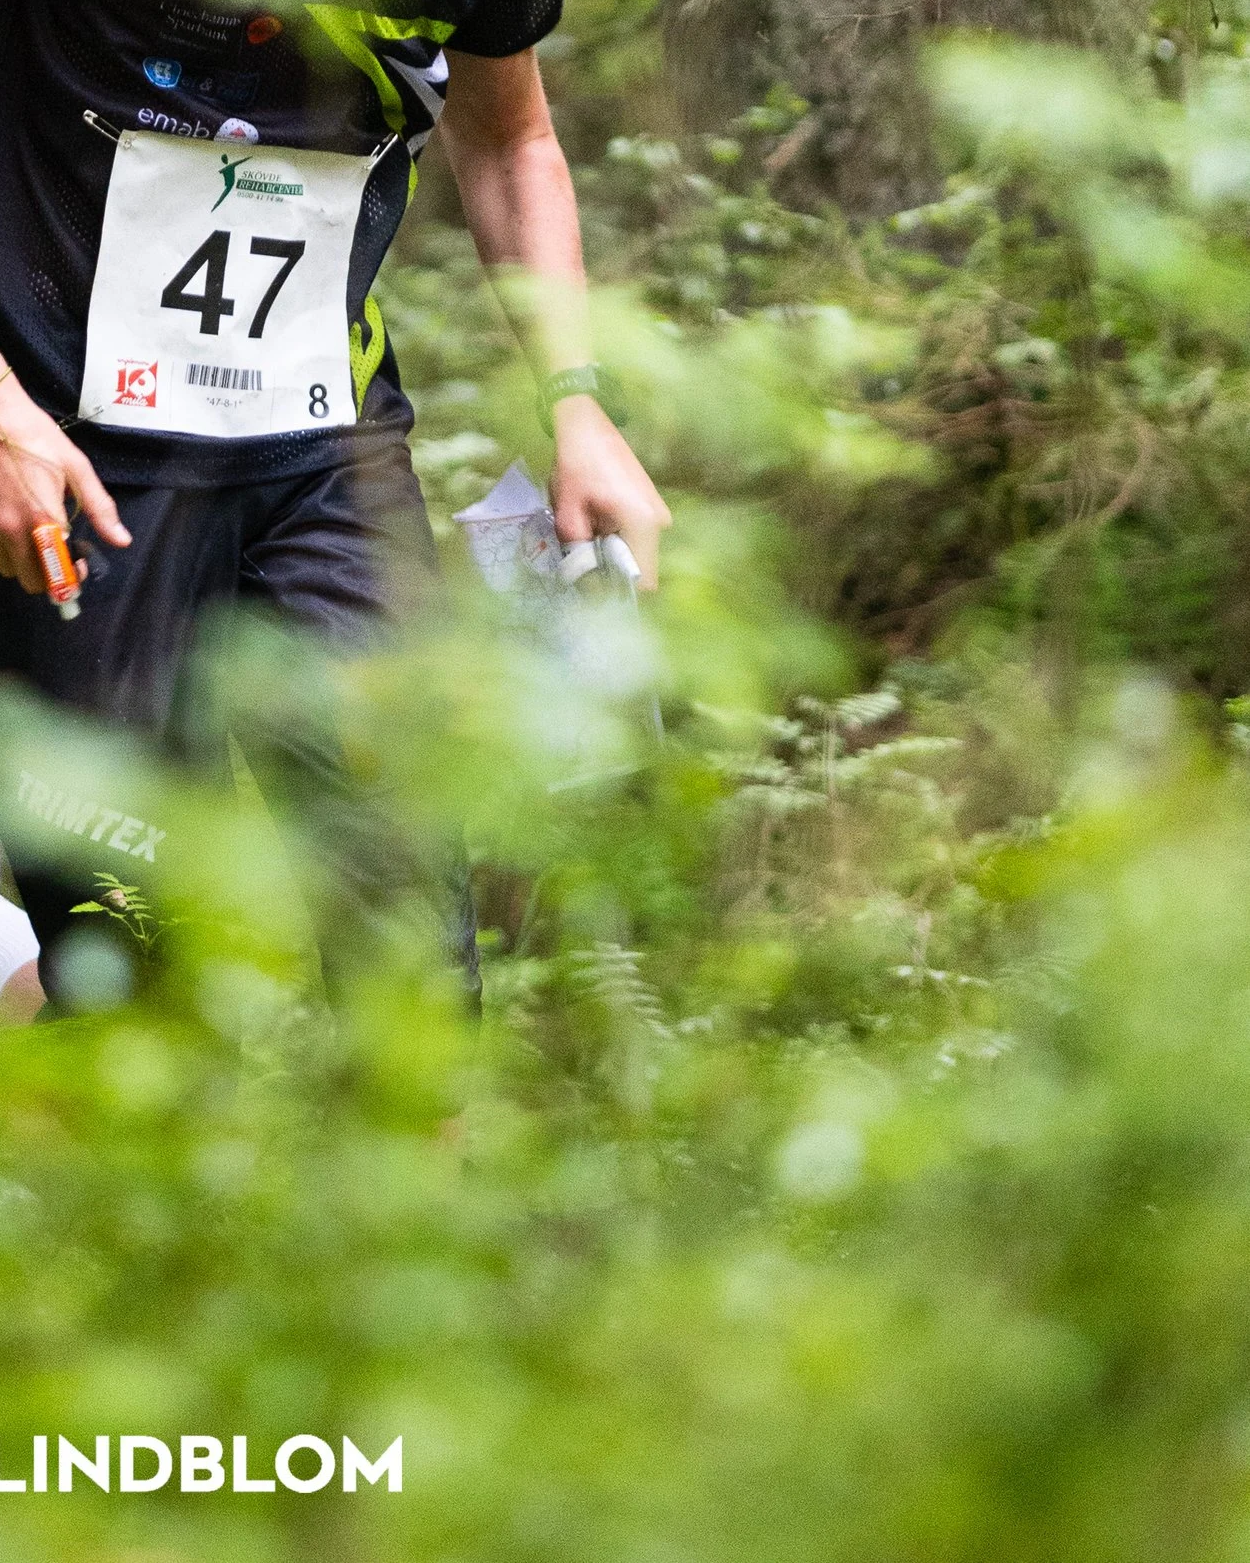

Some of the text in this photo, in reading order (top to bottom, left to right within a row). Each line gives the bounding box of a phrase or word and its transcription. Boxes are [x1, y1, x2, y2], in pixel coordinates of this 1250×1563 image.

[138, 108, 210, 138] emab
[241, 170, 282, 182] SKÖVDE
[160, 229, 306, 339] 47
[309, 383, 329, 418] 8
[17, 770, 166, 863] TRIMTEX
